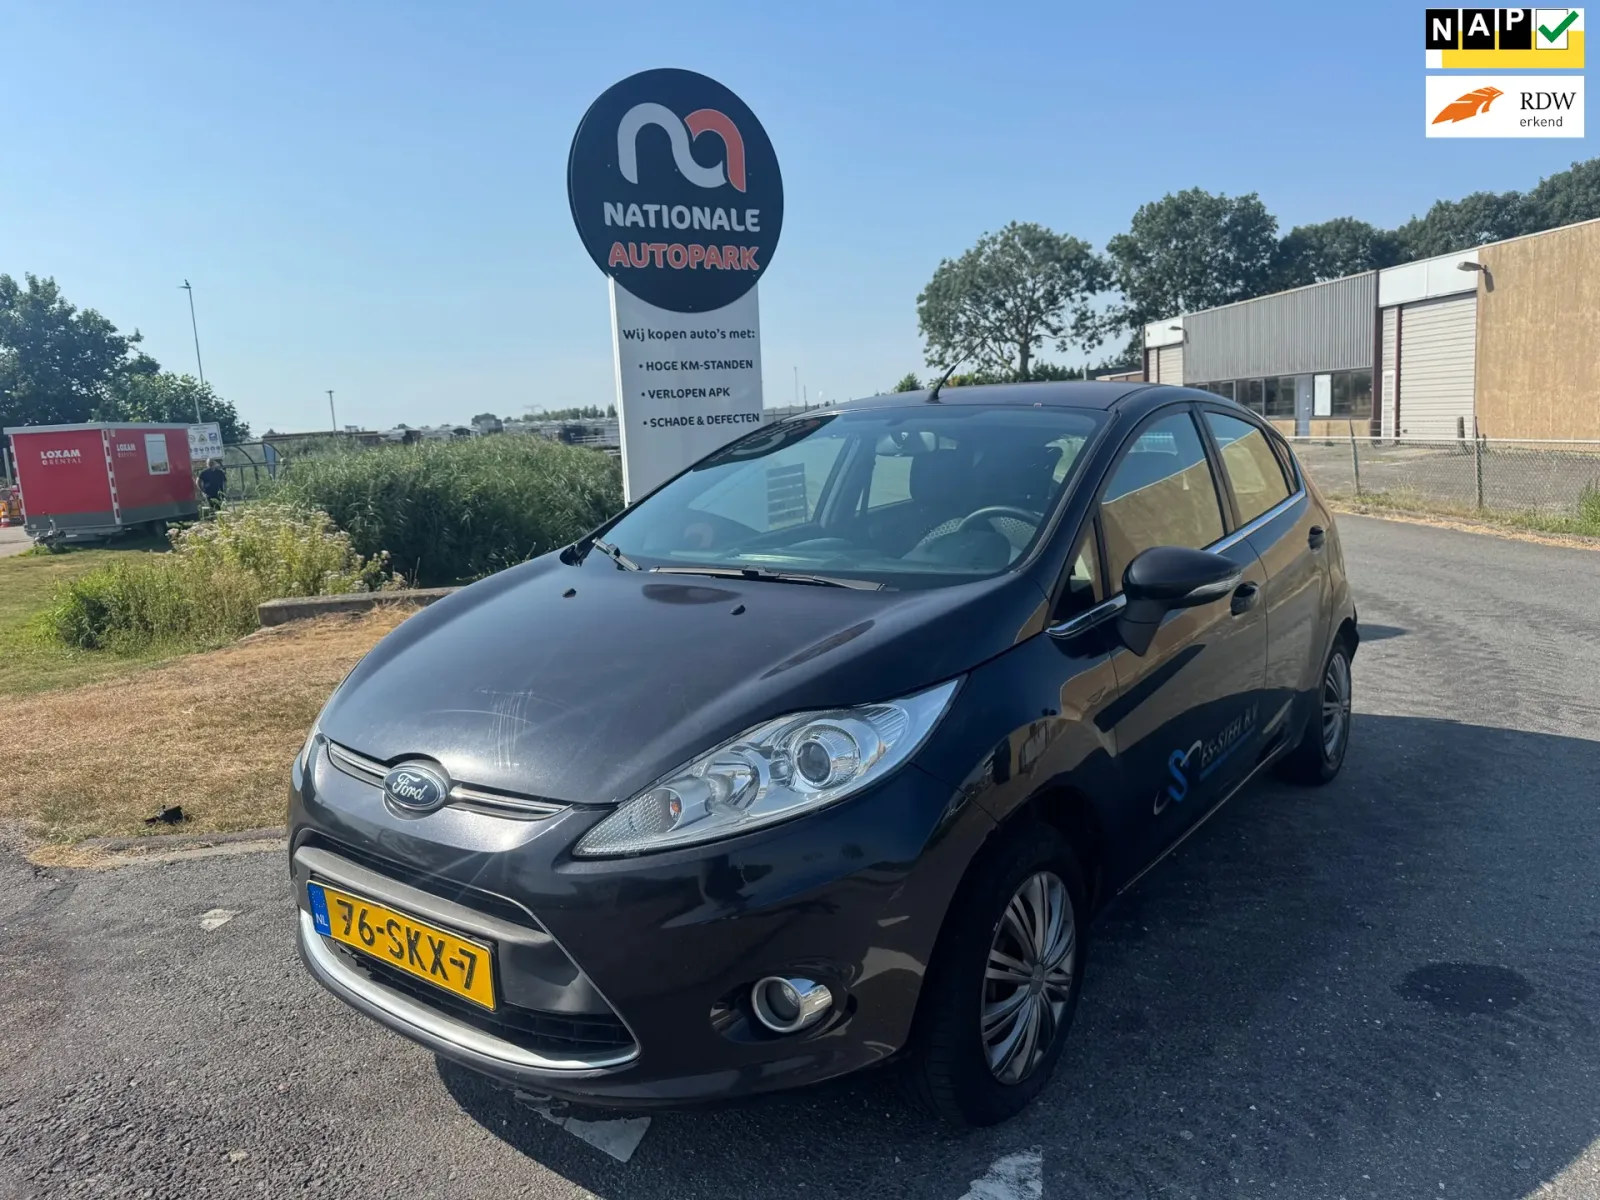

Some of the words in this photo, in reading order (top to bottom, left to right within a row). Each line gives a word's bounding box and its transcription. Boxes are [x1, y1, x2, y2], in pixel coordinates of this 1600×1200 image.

[603, 202, 761, 232] NATIONALE
[608, 241, 760, 271] AUTOPARK
[622, 328, 645, 342] Wij
[648, 328, 687, 341] kopen
[690, 328, 726, 339] auto's
[729, 329, 756, 339] met:
[646, 361, 678, 371] HOGE
[681, 360, 753, 371] KM-STANDEN
[648, 388, 706, 399] VERLOPEN
[709, 387, 731, 397] APK
[650, 416, 695, 428] SCHADE
[697, 416, 705, 426] &
[707, 413, 760, 425] DEFECTEN
[40, 449, 81, 459] LOXAM
[392, 773, 428, 801] Ford
[315, 913, 328, 927] NL
[336, 898, 478, 990] 76-SKX-7
